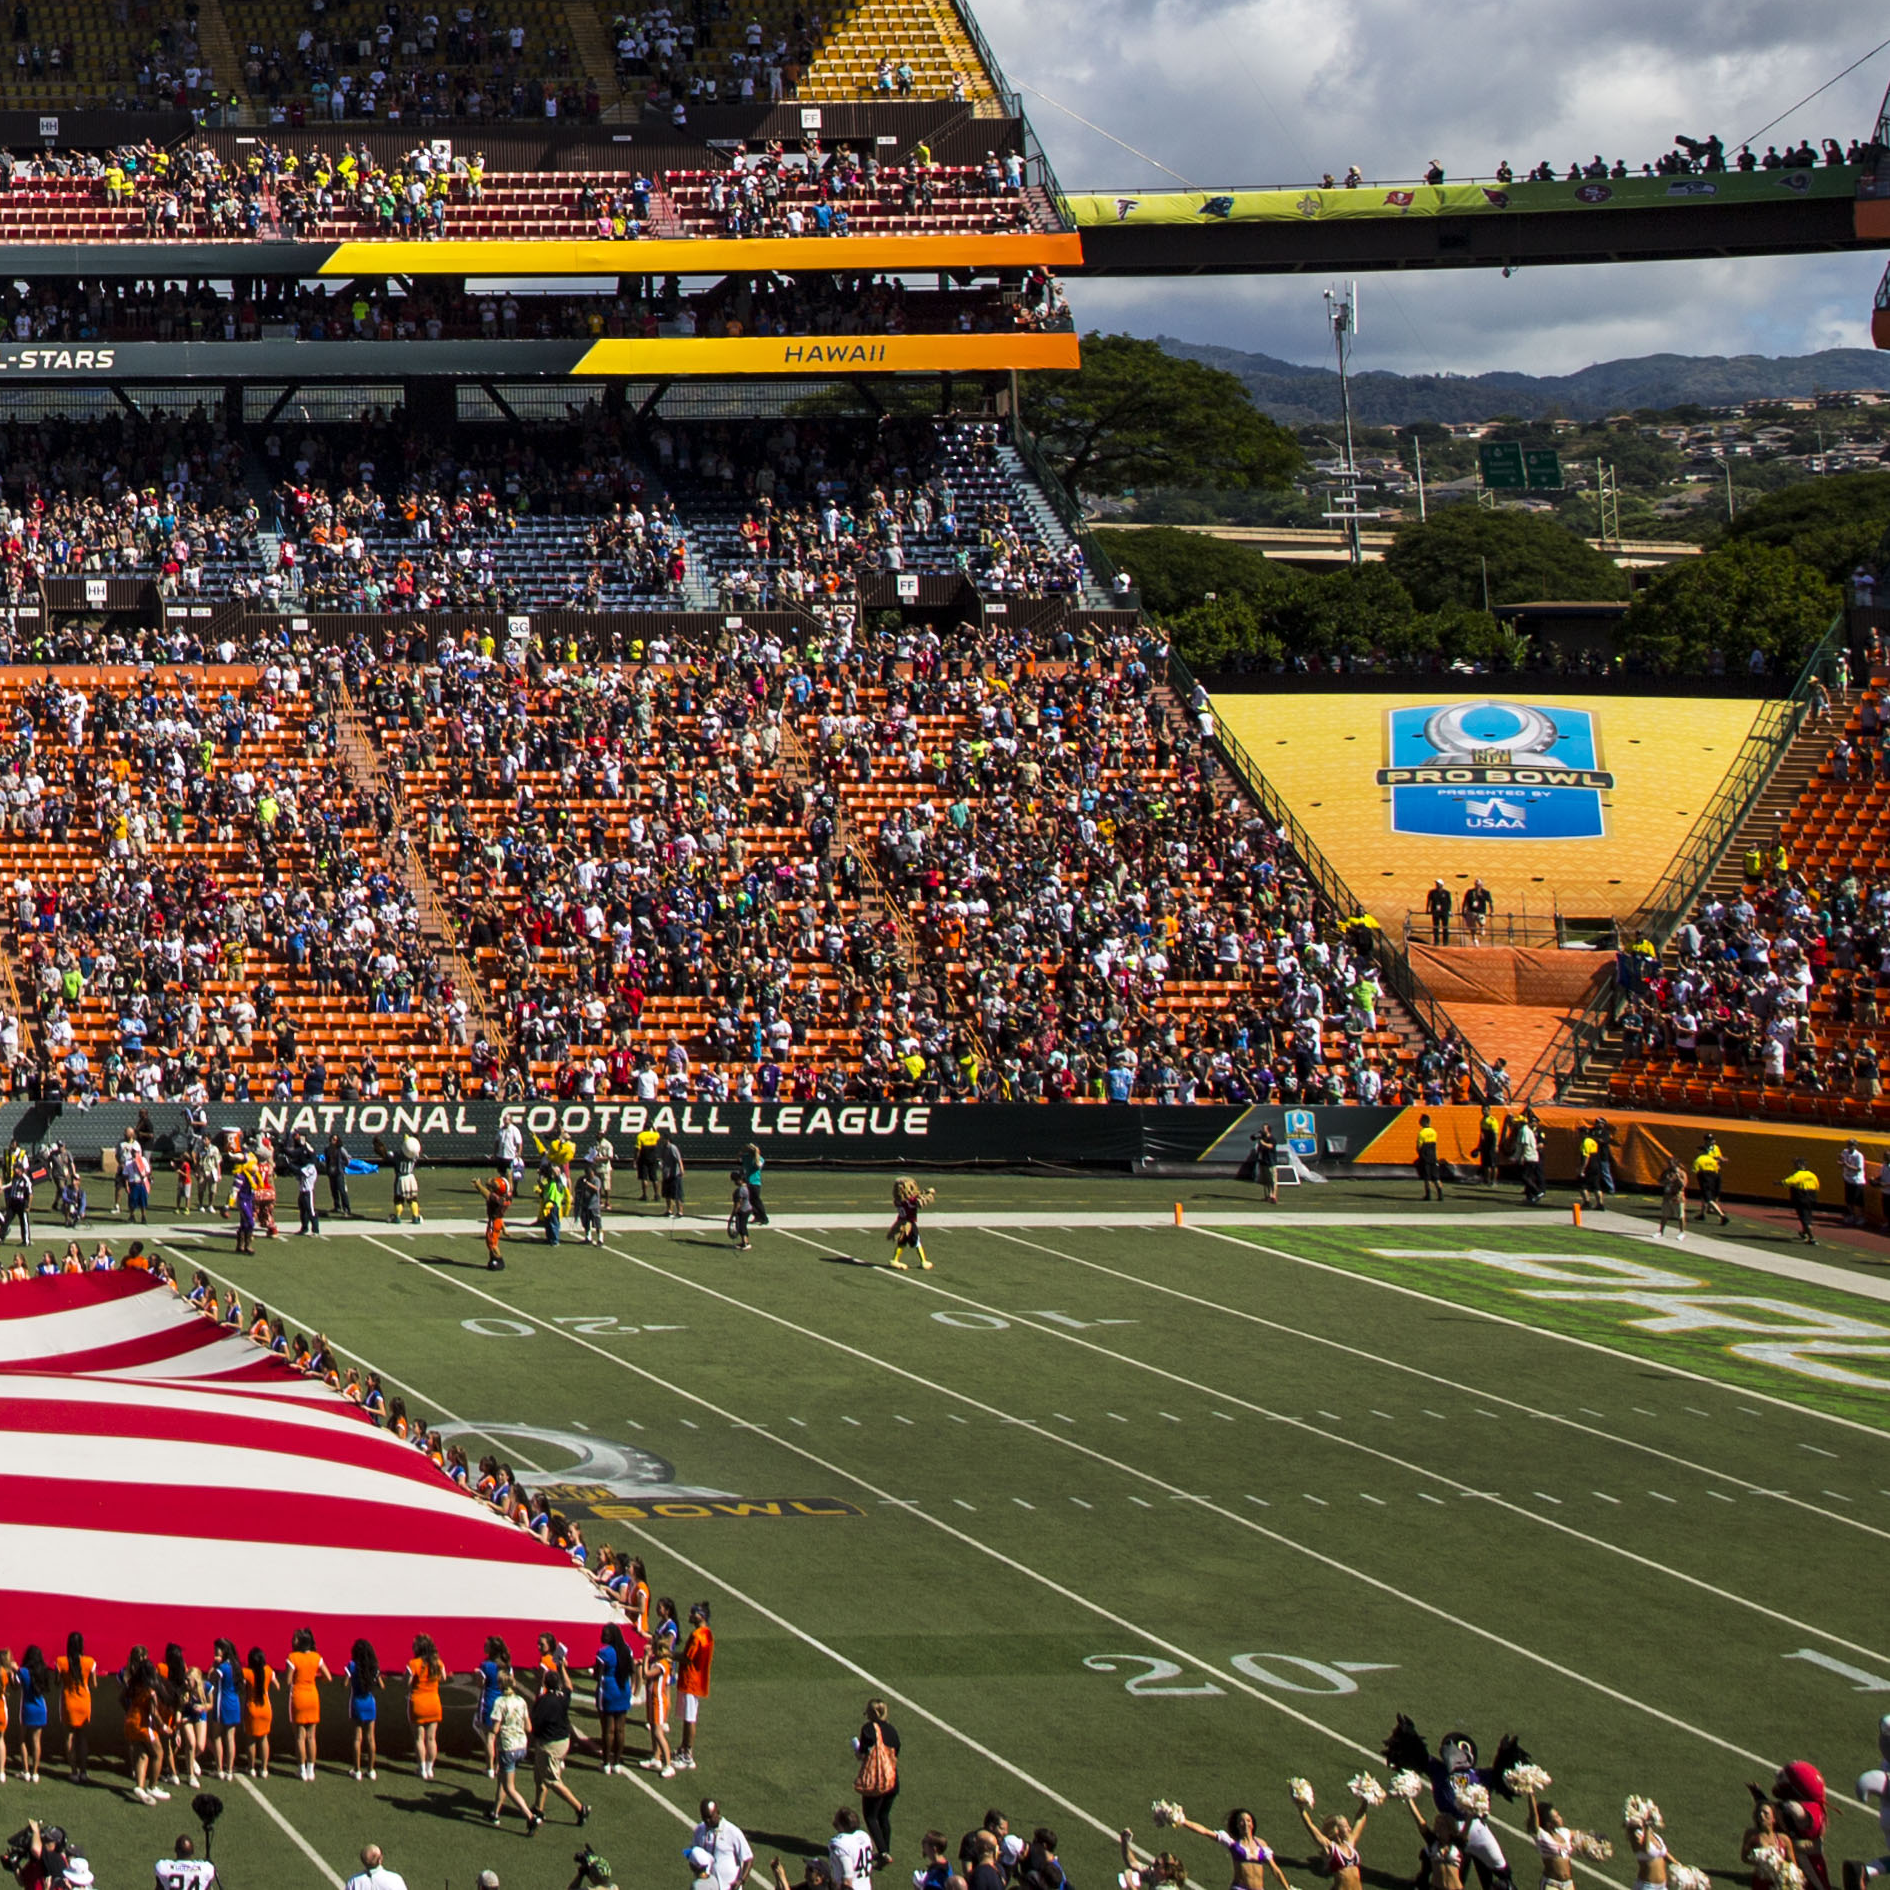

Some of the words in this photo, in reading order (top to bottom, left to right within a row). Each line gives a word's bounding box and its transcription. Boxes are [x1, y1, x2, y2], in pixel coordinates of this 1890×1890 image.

[783, 345, 887, 364] HAWAII
[88, 585, 105, 596] HH
[900, 581, 915, 591] FF
[509, 621, 529, 633] GG
[1386, 769, 1474, 783] PRO
[1486, 770, 1606, 787] BOWL
[1437, 789, 1526, 797] PRESENTED
[1466, 818, 1526, 829] USAA
[257, 1106, 477, 1134] NATIONAL
[751, 1107, 931, 1134] LEAGUE
[588, 1501, 847, 1520] BOWL
[1081, 1651, 1359, 1696] 20
